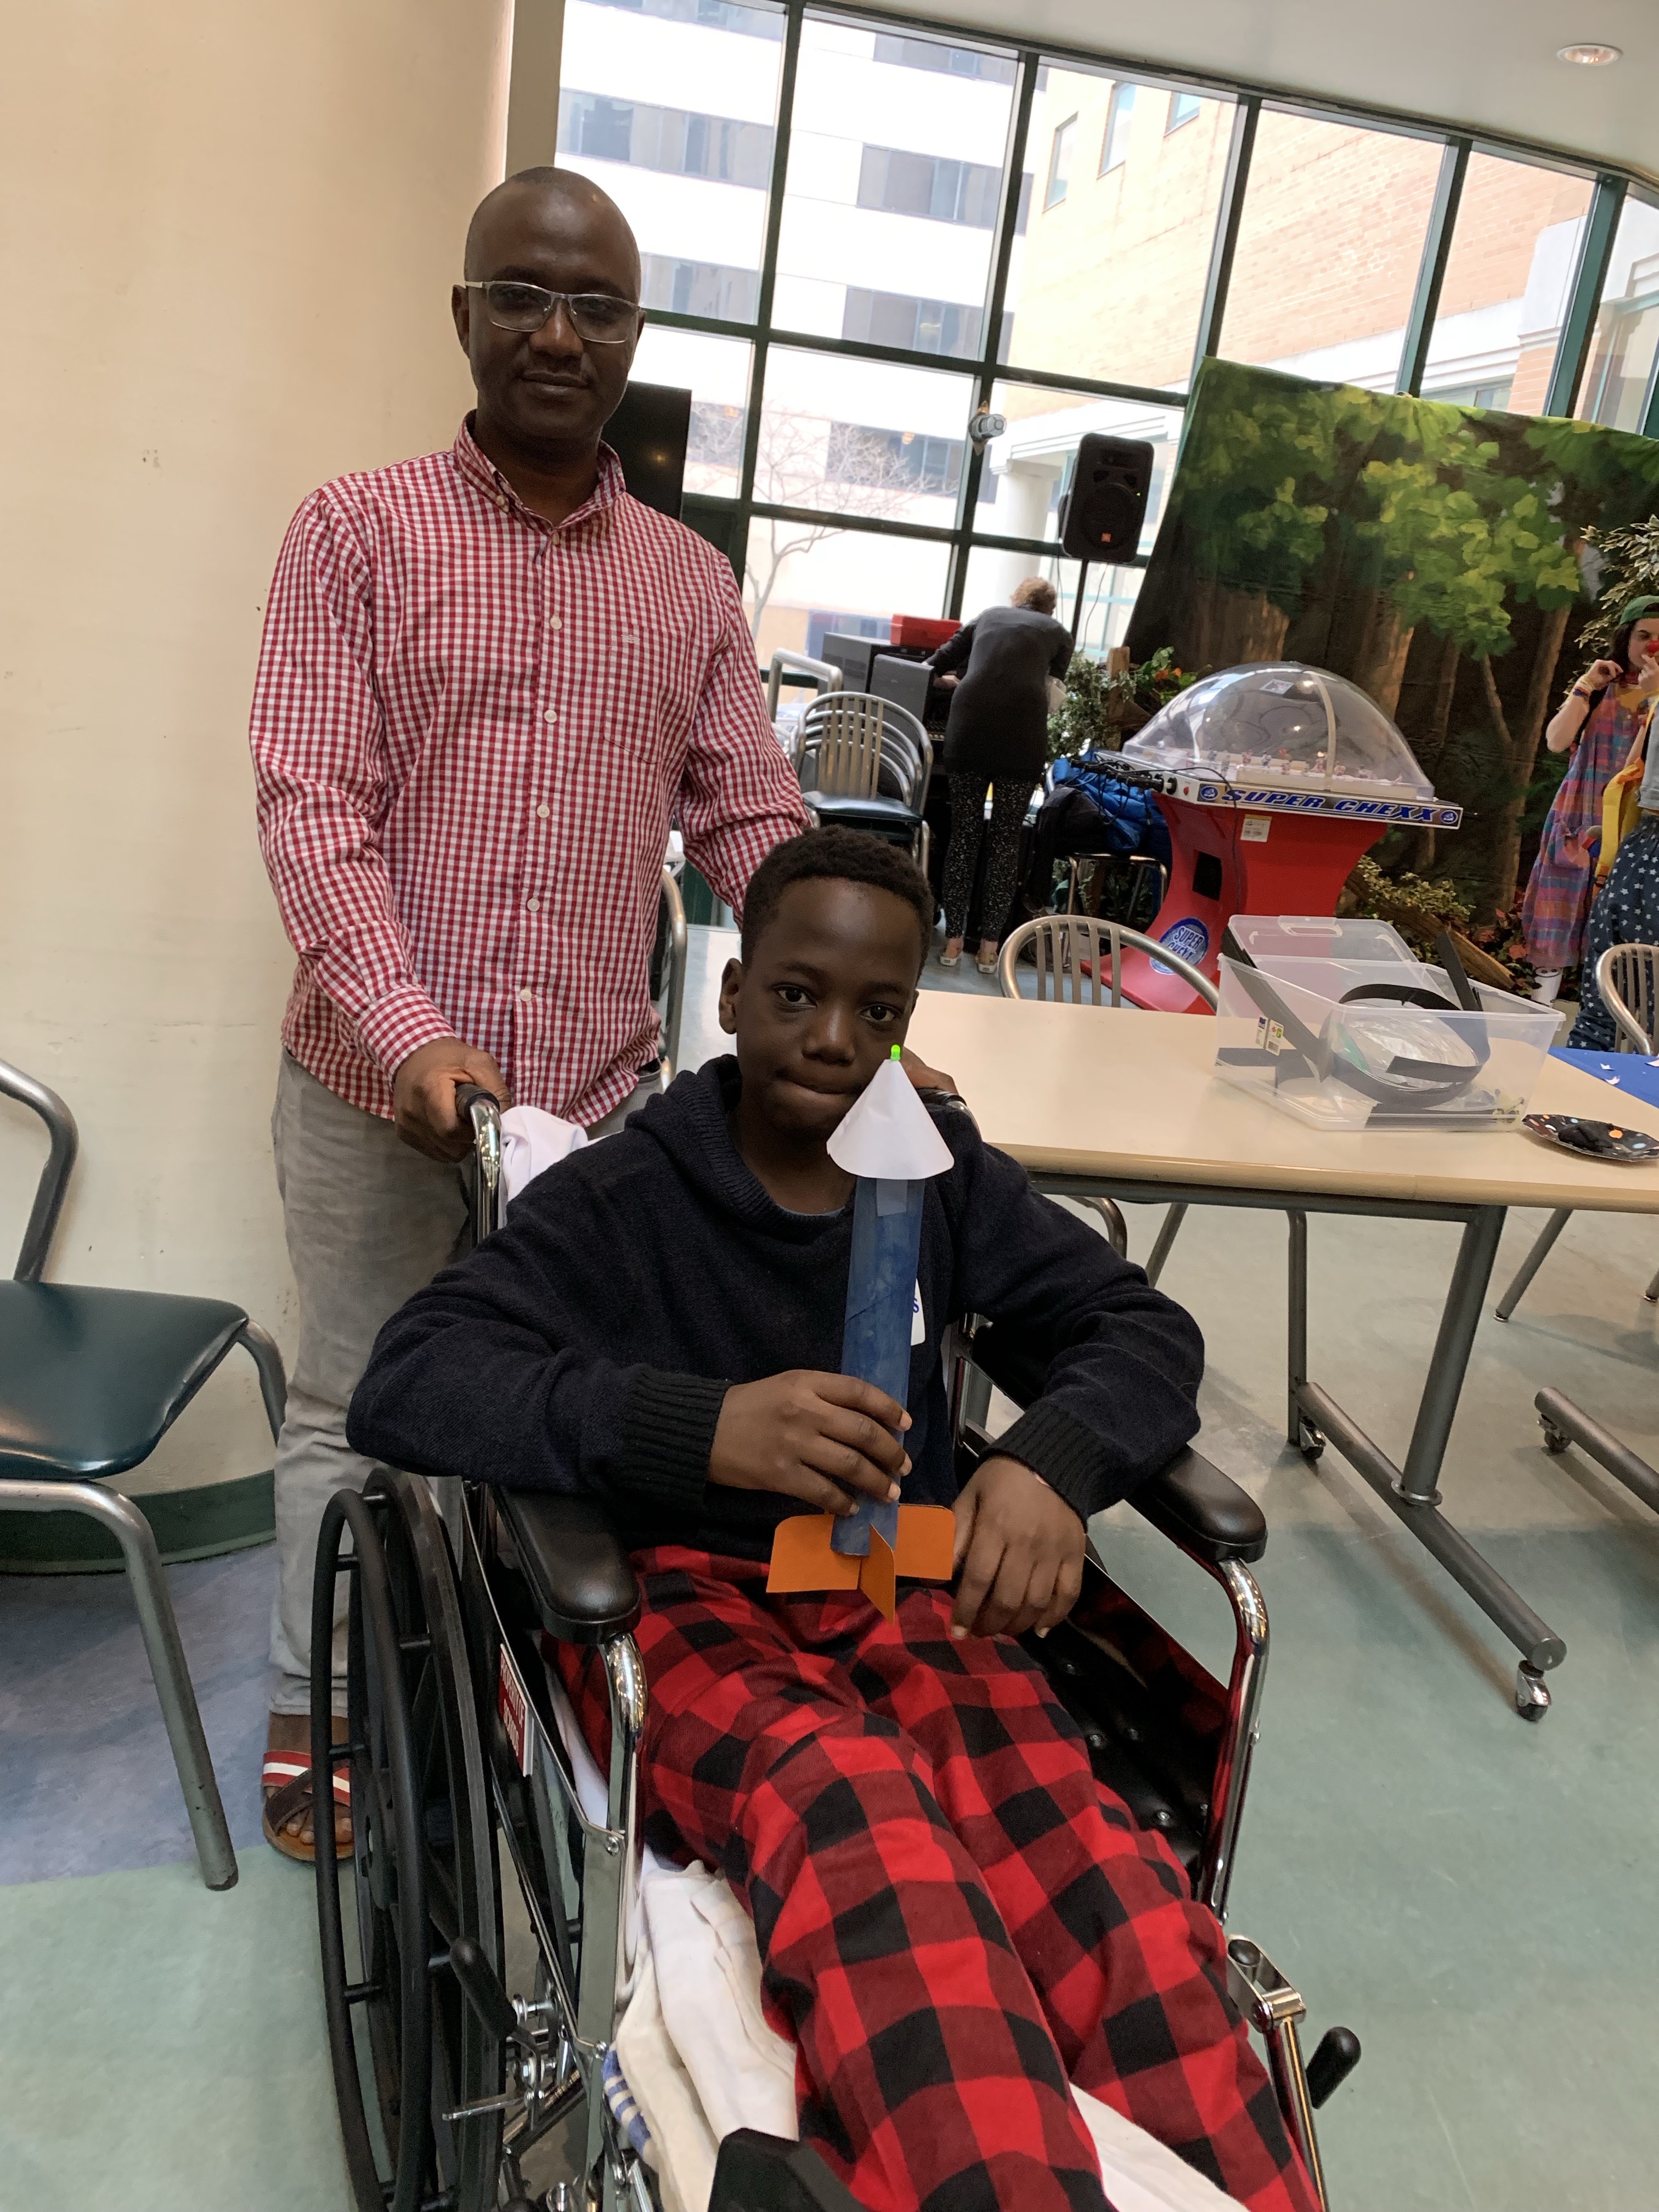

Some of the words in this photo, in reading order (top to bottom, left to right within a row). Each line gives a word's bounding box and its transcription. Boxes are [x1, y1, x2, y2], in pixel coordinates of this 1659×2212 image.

[1221, 789, 1325, 808] SUPER
[1334, 800, 1440, 821] CHEXX
[1173, 926, 1205, 950] SUPER
[500, 1652, 520, 1716] PROPERTY
[518, 1698, 524, 1728] OF
